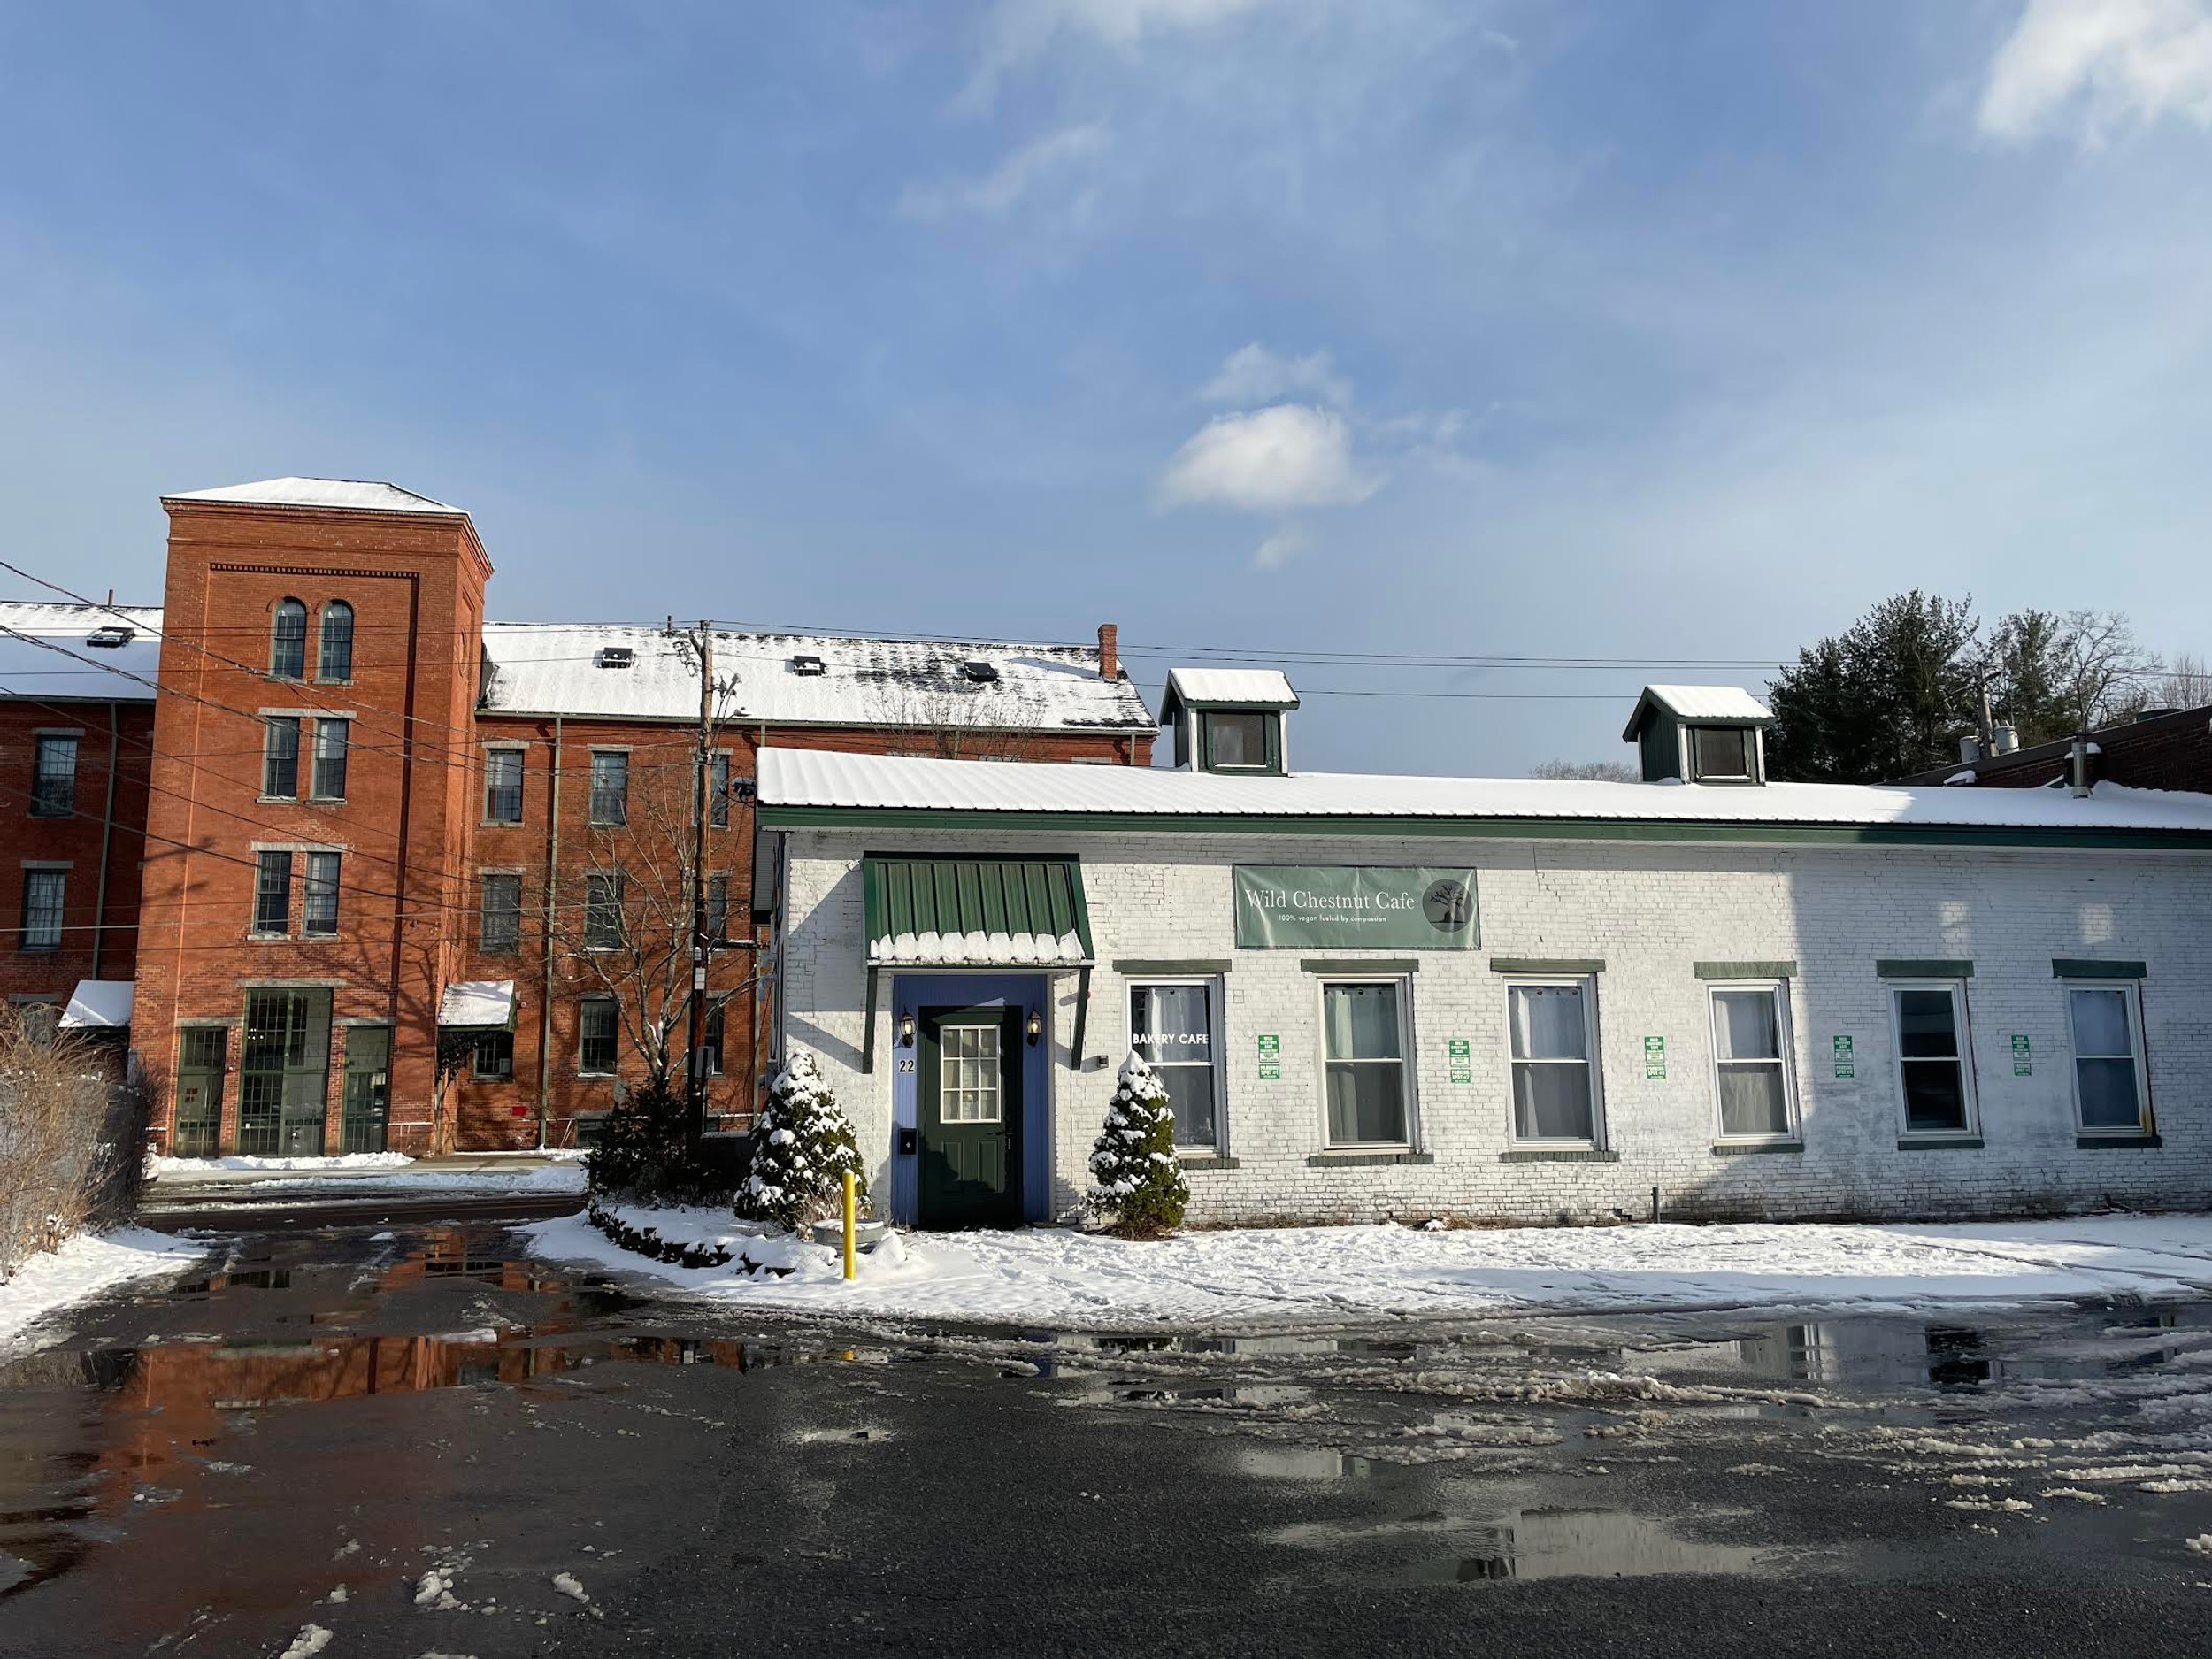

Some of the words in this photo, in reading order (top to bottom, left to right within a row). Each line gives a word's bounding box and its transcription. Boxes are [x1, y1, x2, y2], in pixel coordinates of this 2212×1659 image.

[1245, 889, 1286, 908] Wild
[1293, 890, 1371, 910] Chestnut
[1376, 891, 1415, 910] Cafe
[1340, 914, 1349, 923] by
[1133, 1033, 1175, 1044] BAKRY
[1179, 1033, 1210, 1044] CAFE
[899, 1060, 914, 1072] 22
